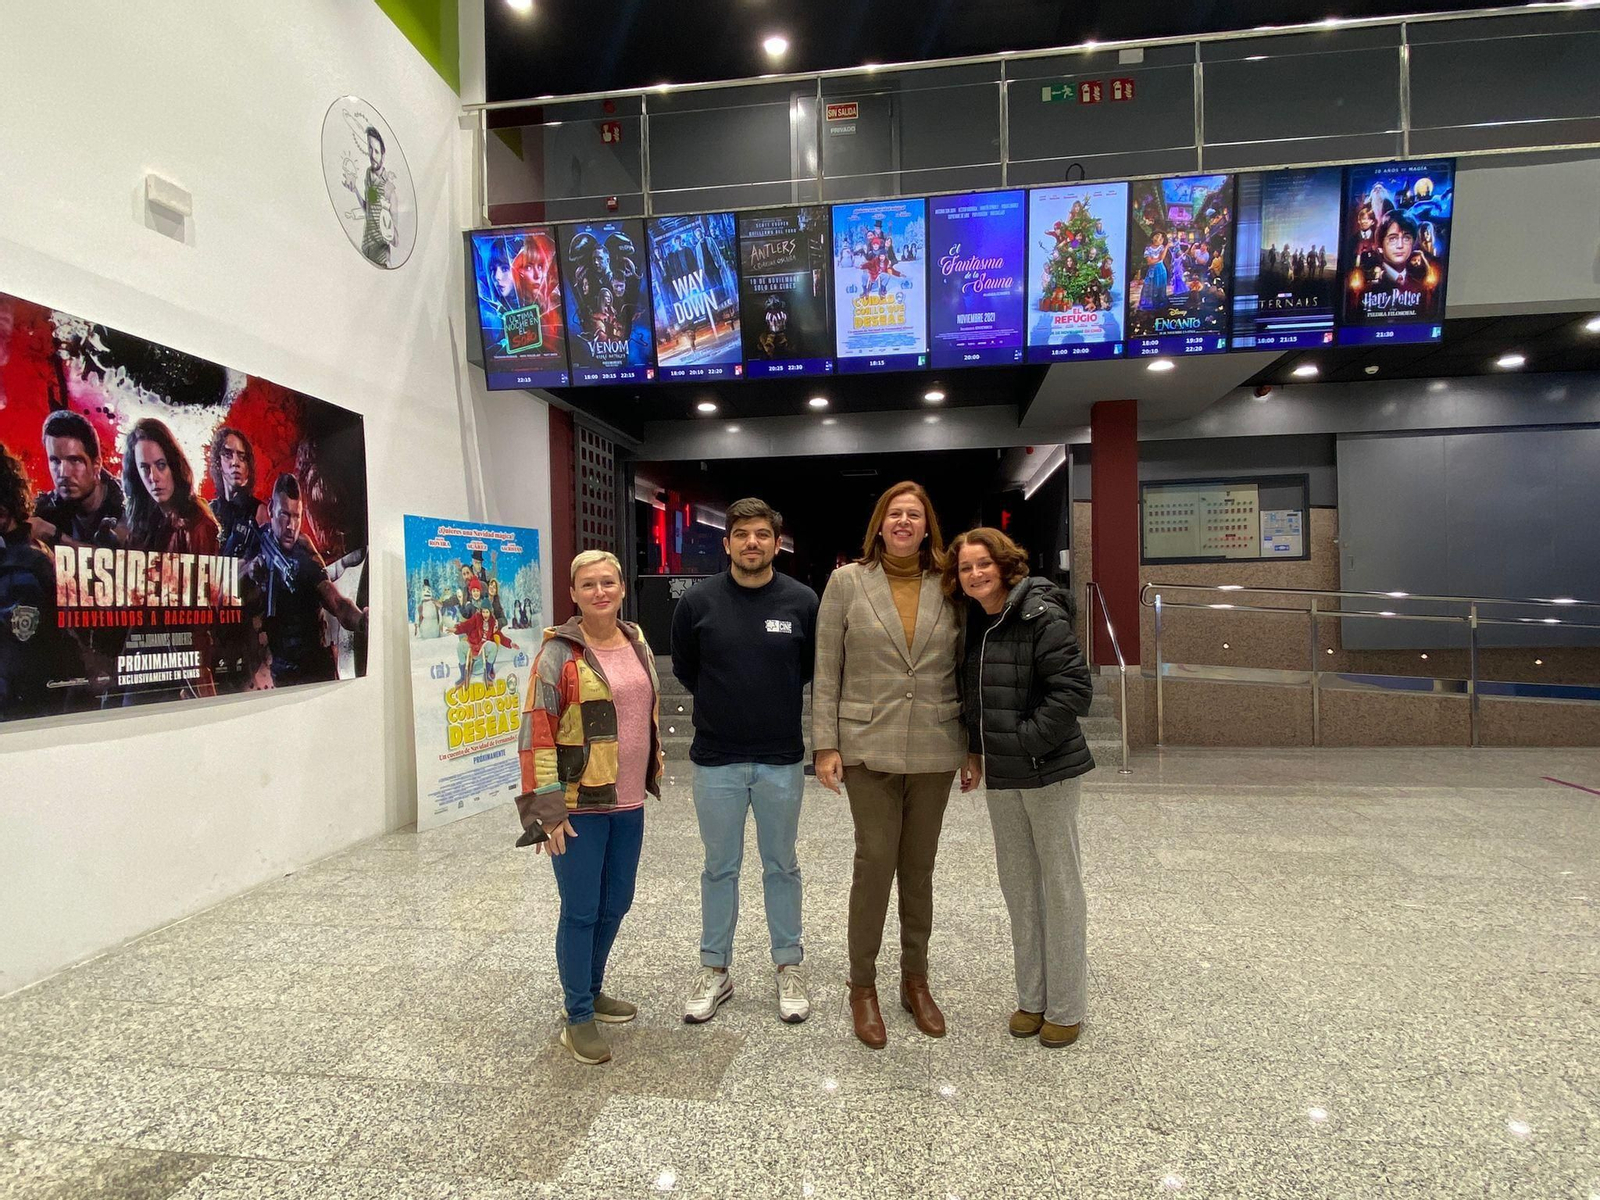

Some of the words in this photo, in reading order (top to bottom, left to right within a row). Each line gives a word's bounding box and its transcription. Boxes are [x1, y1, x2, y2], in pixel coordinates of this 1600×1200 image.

[828, 109, 837, 118] SIN
[838, 107, 857, 117] SALIDA
[750, 238, 796, 266] ANTLERS
[672, 269, 705, 300] WAY
[1362, 291, 1392, 312] Harry
[1391, 288, 1422, 306] Potter
[673, 289, 718, 336] DOWN
[1054, 313, 1098, 324] REFUGIO
[1154, 317, 1201, 332] ENCANTO
[588, 337, 630, 357] VENOM
[54, 545, 195, 607] RESIDENT
[197, 554, 242, 607] EVIL
[58, 610, 144, 628] BIENVENIDOS
[150, 610, 157, 626] A
[164, 610, 214, 626] RACCOON
[219, 609, 242, 624] CITY
[118, 651, 200, 673] PRÓXIMAMENTE
[118, 670, 172, 686] EXCLUSIVAMENTE
[174, 670, 182, 680] EN
[182, 668, 200, 679] CINES
[448, 704, 474, 722] CON
[476, 702, 493, 717] LO
[496, 696, 518, 712] QUE
[448, 710, 520, 748] DESEAS
